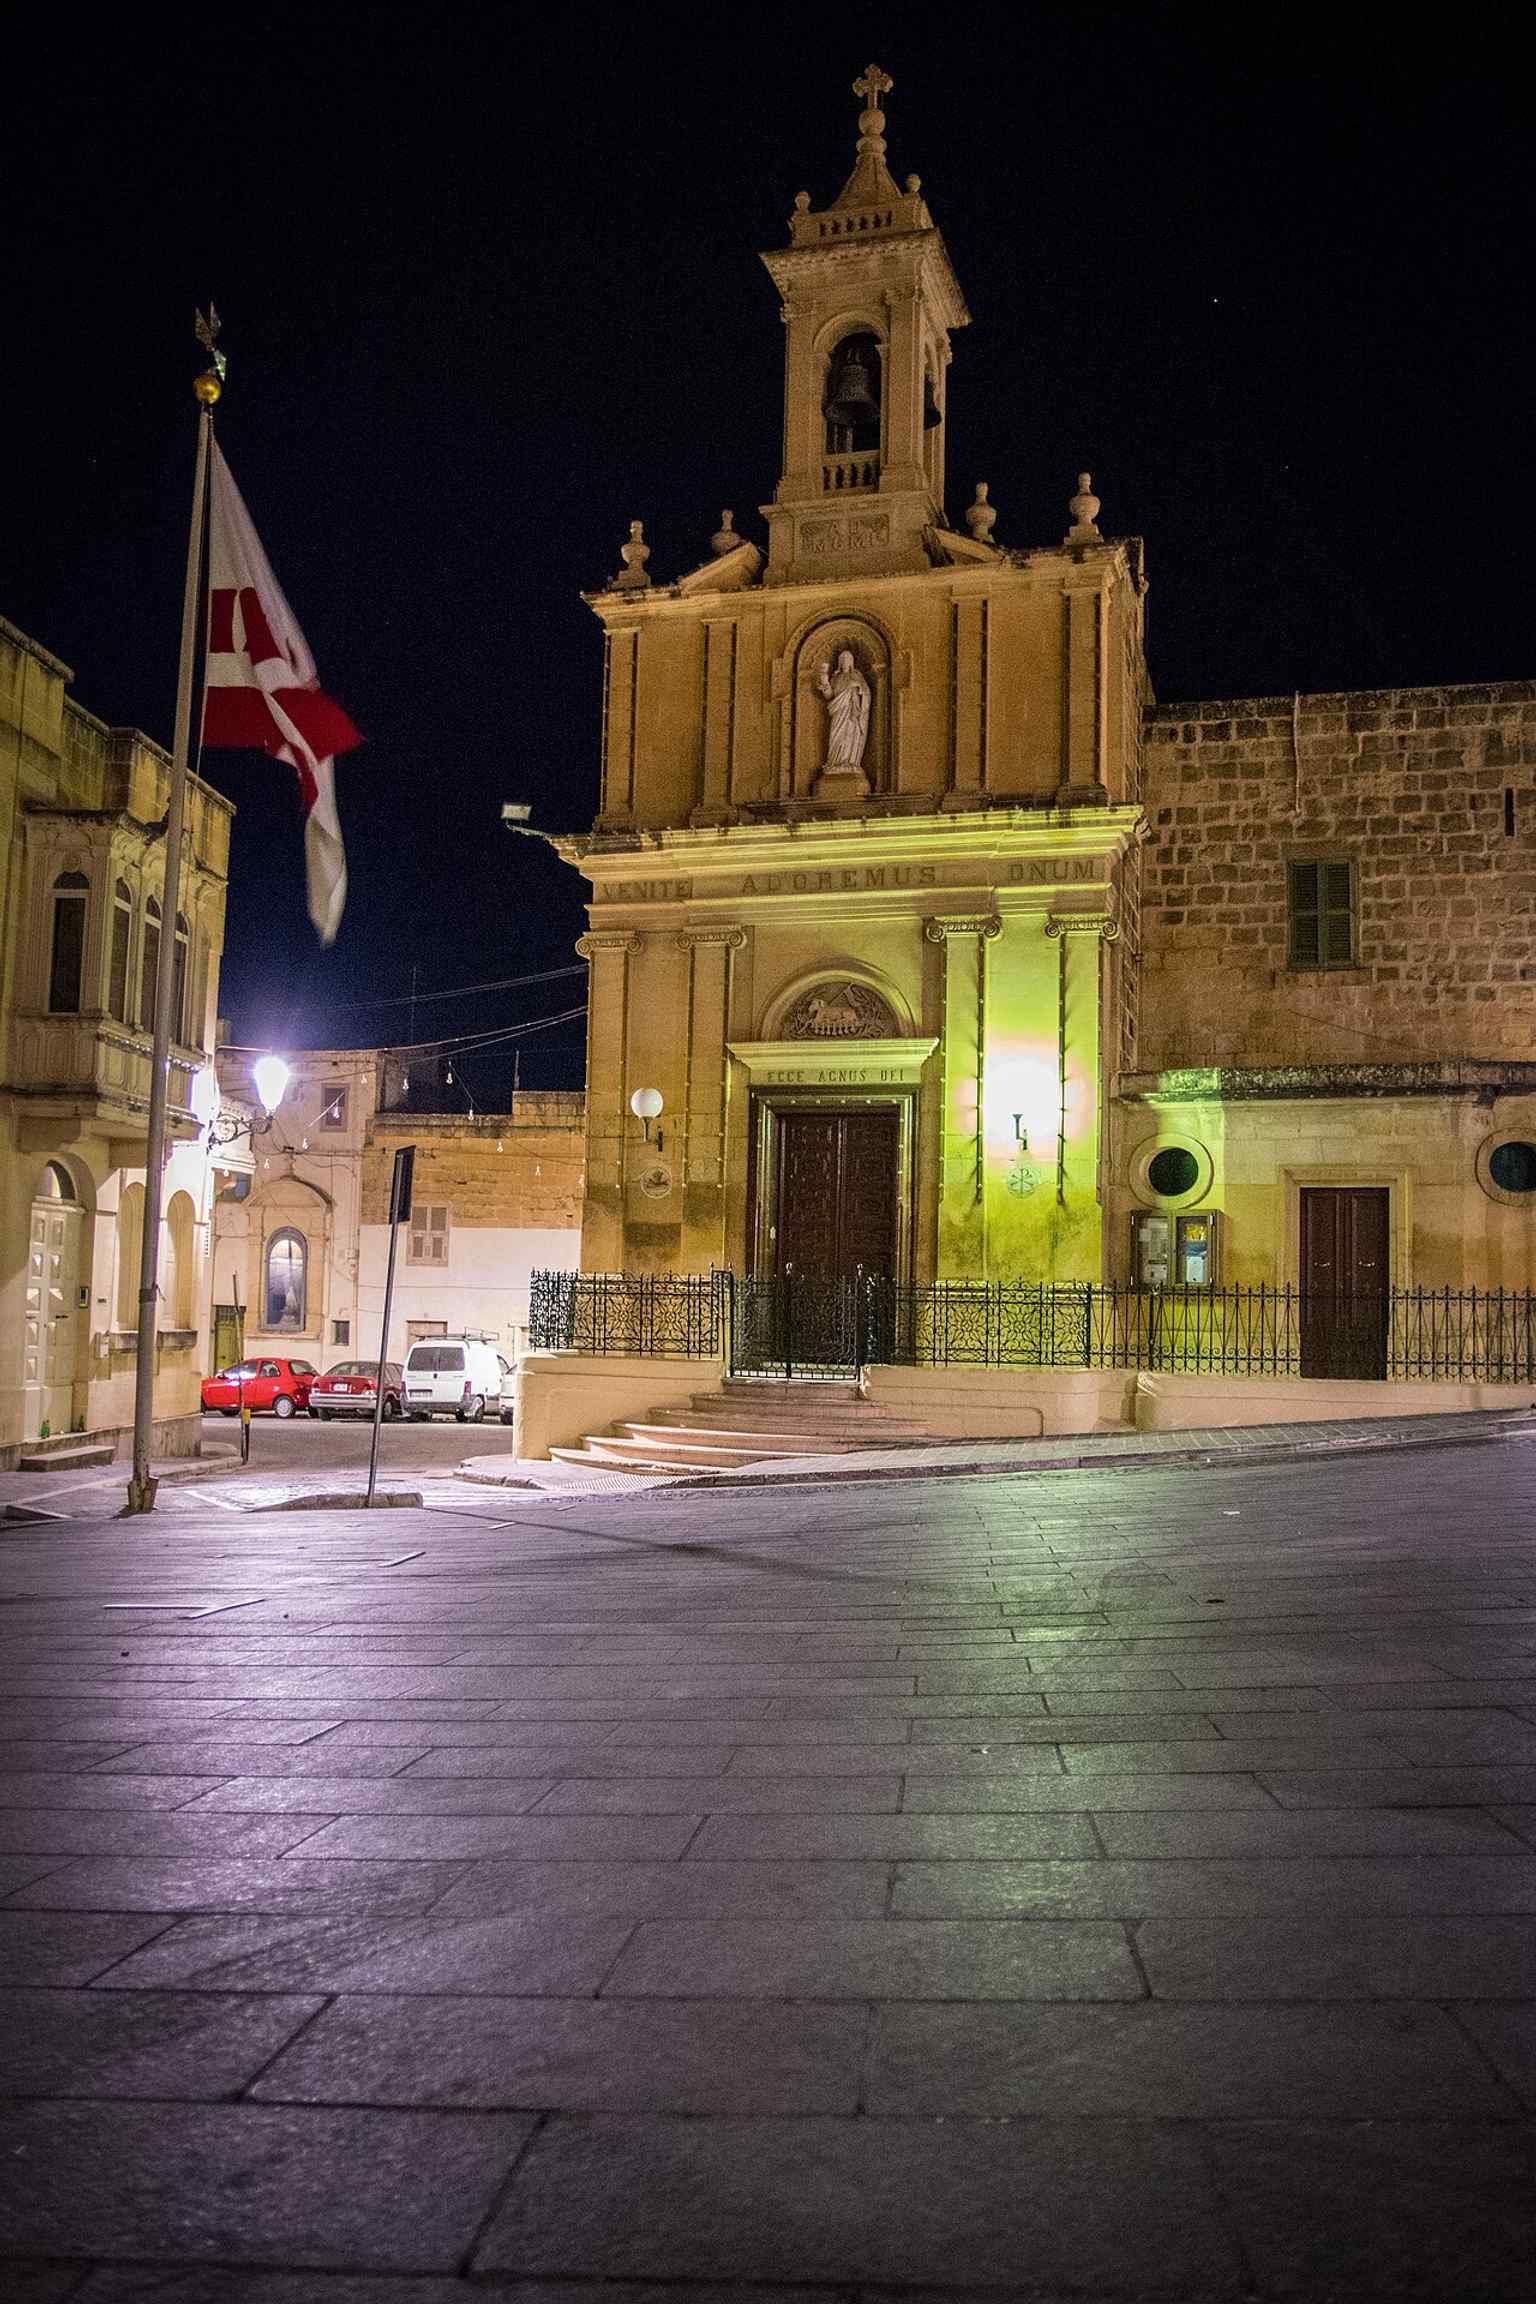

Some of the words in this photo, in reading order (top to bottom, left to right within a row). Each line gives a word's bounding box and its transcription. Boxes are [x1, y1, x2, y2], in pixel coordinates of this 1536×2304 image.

[602, 880, 689, 899] VENITE
[741, 865, 936, 894] ADOREMUS
[767, 1070, 805, 1083] ECCE
[818, 1069, 867, 1083] AGNUS
[880, 1068, 905, 1082] DEI
